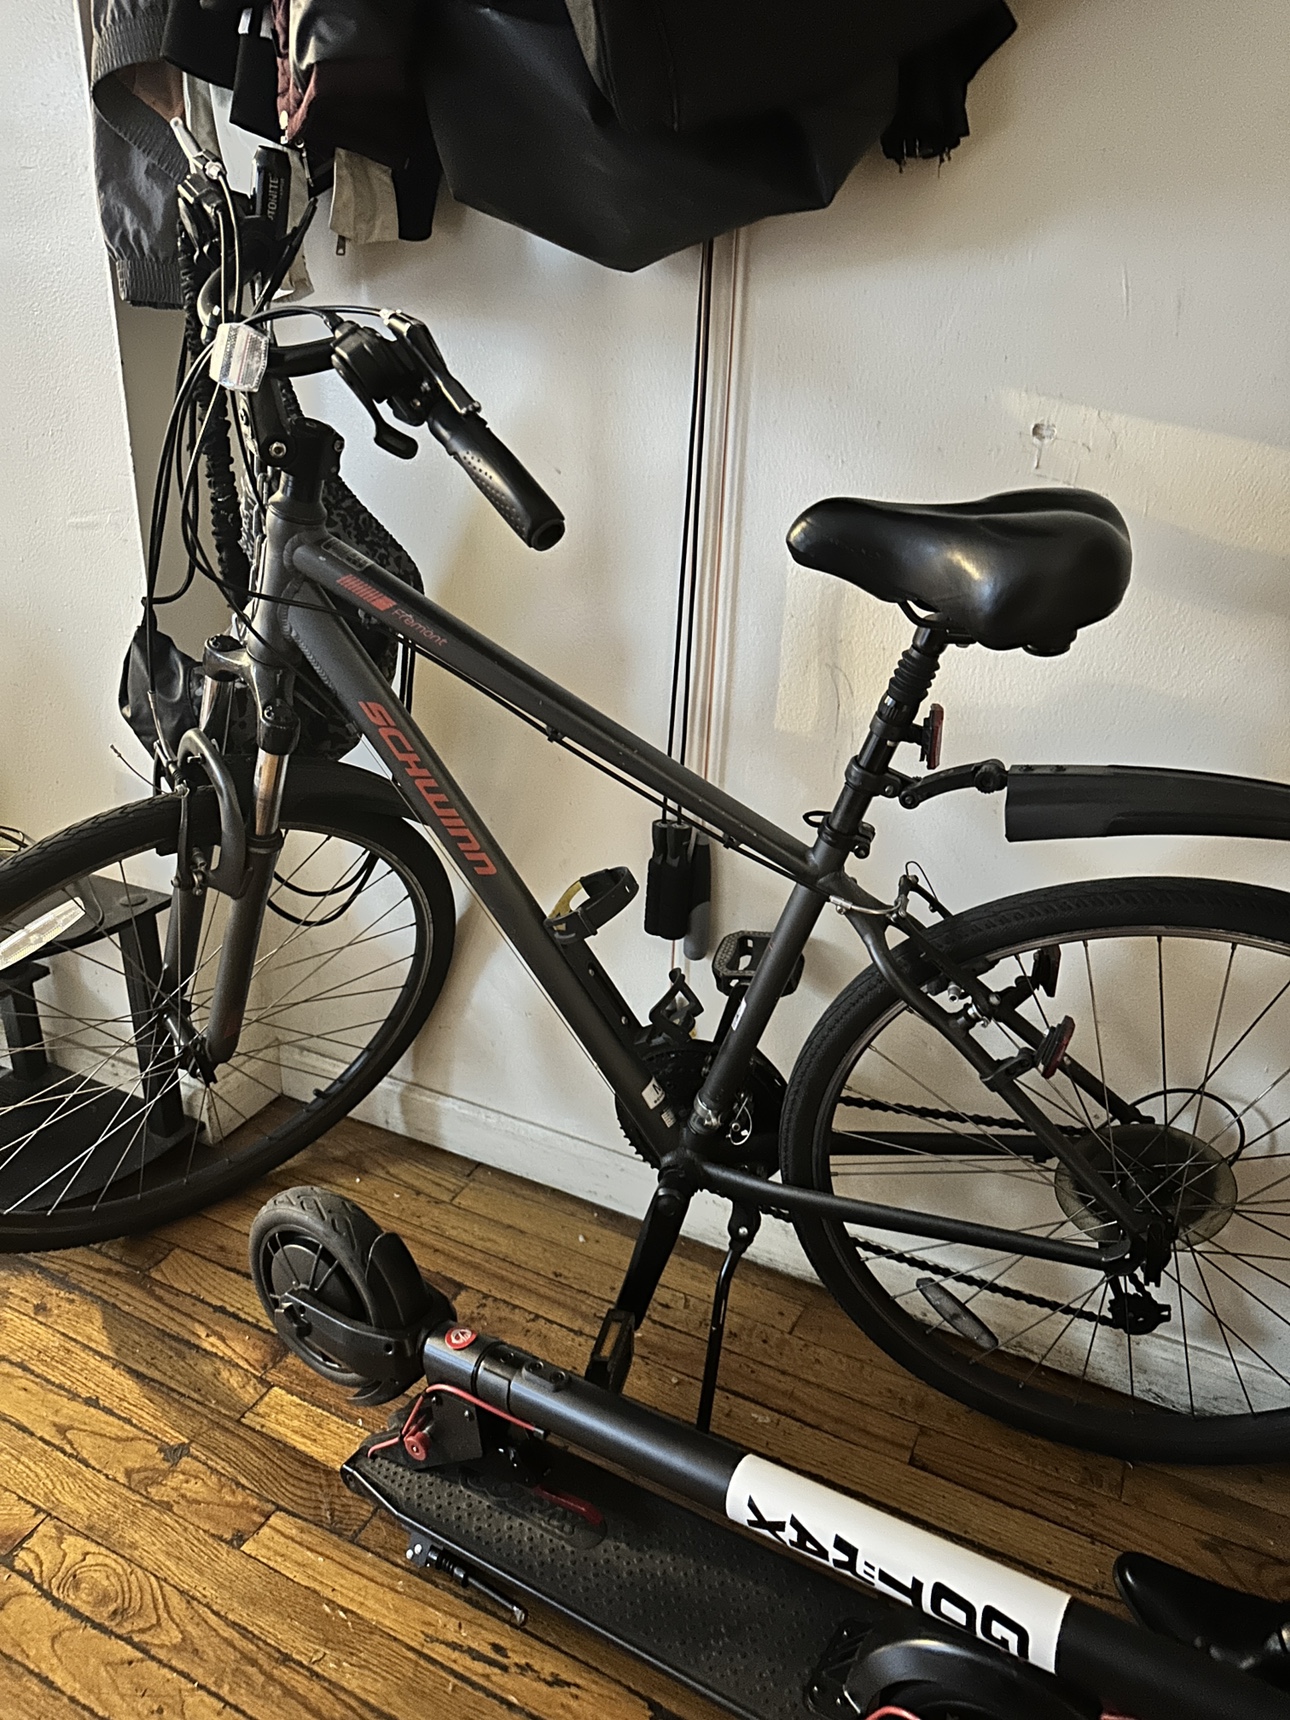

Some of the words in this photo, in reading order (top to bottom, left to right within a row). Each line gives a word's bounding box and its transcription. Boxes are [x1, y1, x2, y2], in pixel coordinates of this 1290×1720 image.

[391, 608, 448, 646] Fremont
[358, 701, 497, 876] SCHWINN
[746, 1494, 1030, 1662] GOTRAX
